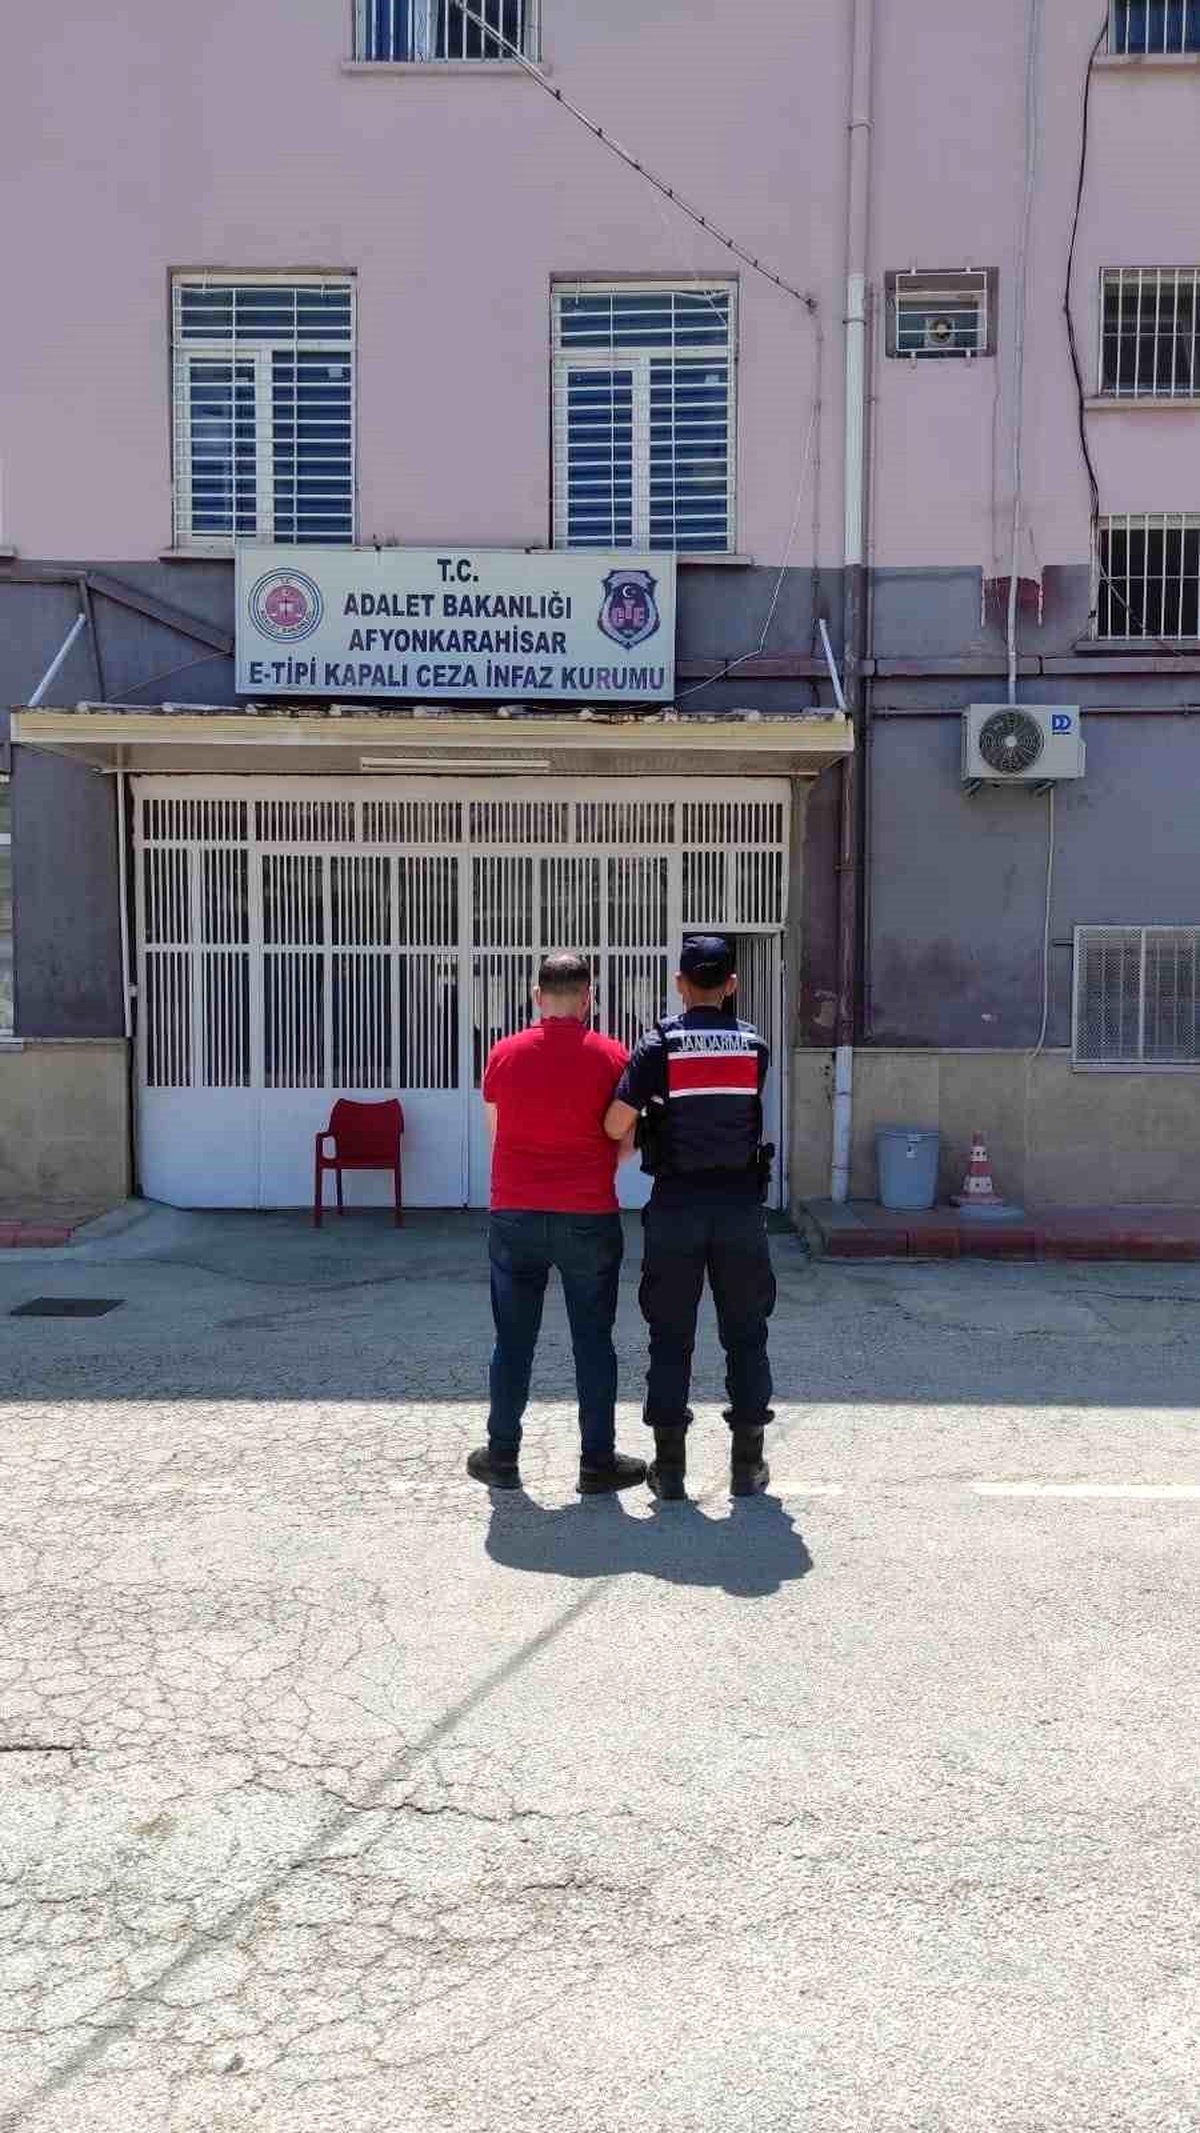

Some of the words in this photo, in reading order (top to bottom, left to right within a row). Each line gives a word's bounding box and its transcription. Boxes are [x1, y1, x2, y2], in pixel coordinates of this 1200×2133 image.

[437, 558, 479, 582] T.C.
[343, 593, 435, 617] ADALET
[443, 591, 571, 619] BAKANLIĞI
[349, 625, 566, 653] AFYONKARAHİSAR
[249, 656, 315, 684] E-TİPİ
[324, 663, 408, 687] KAPALI
[416, 664, 477, 688] CEZA
[487, 660, 554, 688] İNFAZ
[561, 667, 665, 689] KURUMU
[681, 1033, 749, 1052] JANDARMA
